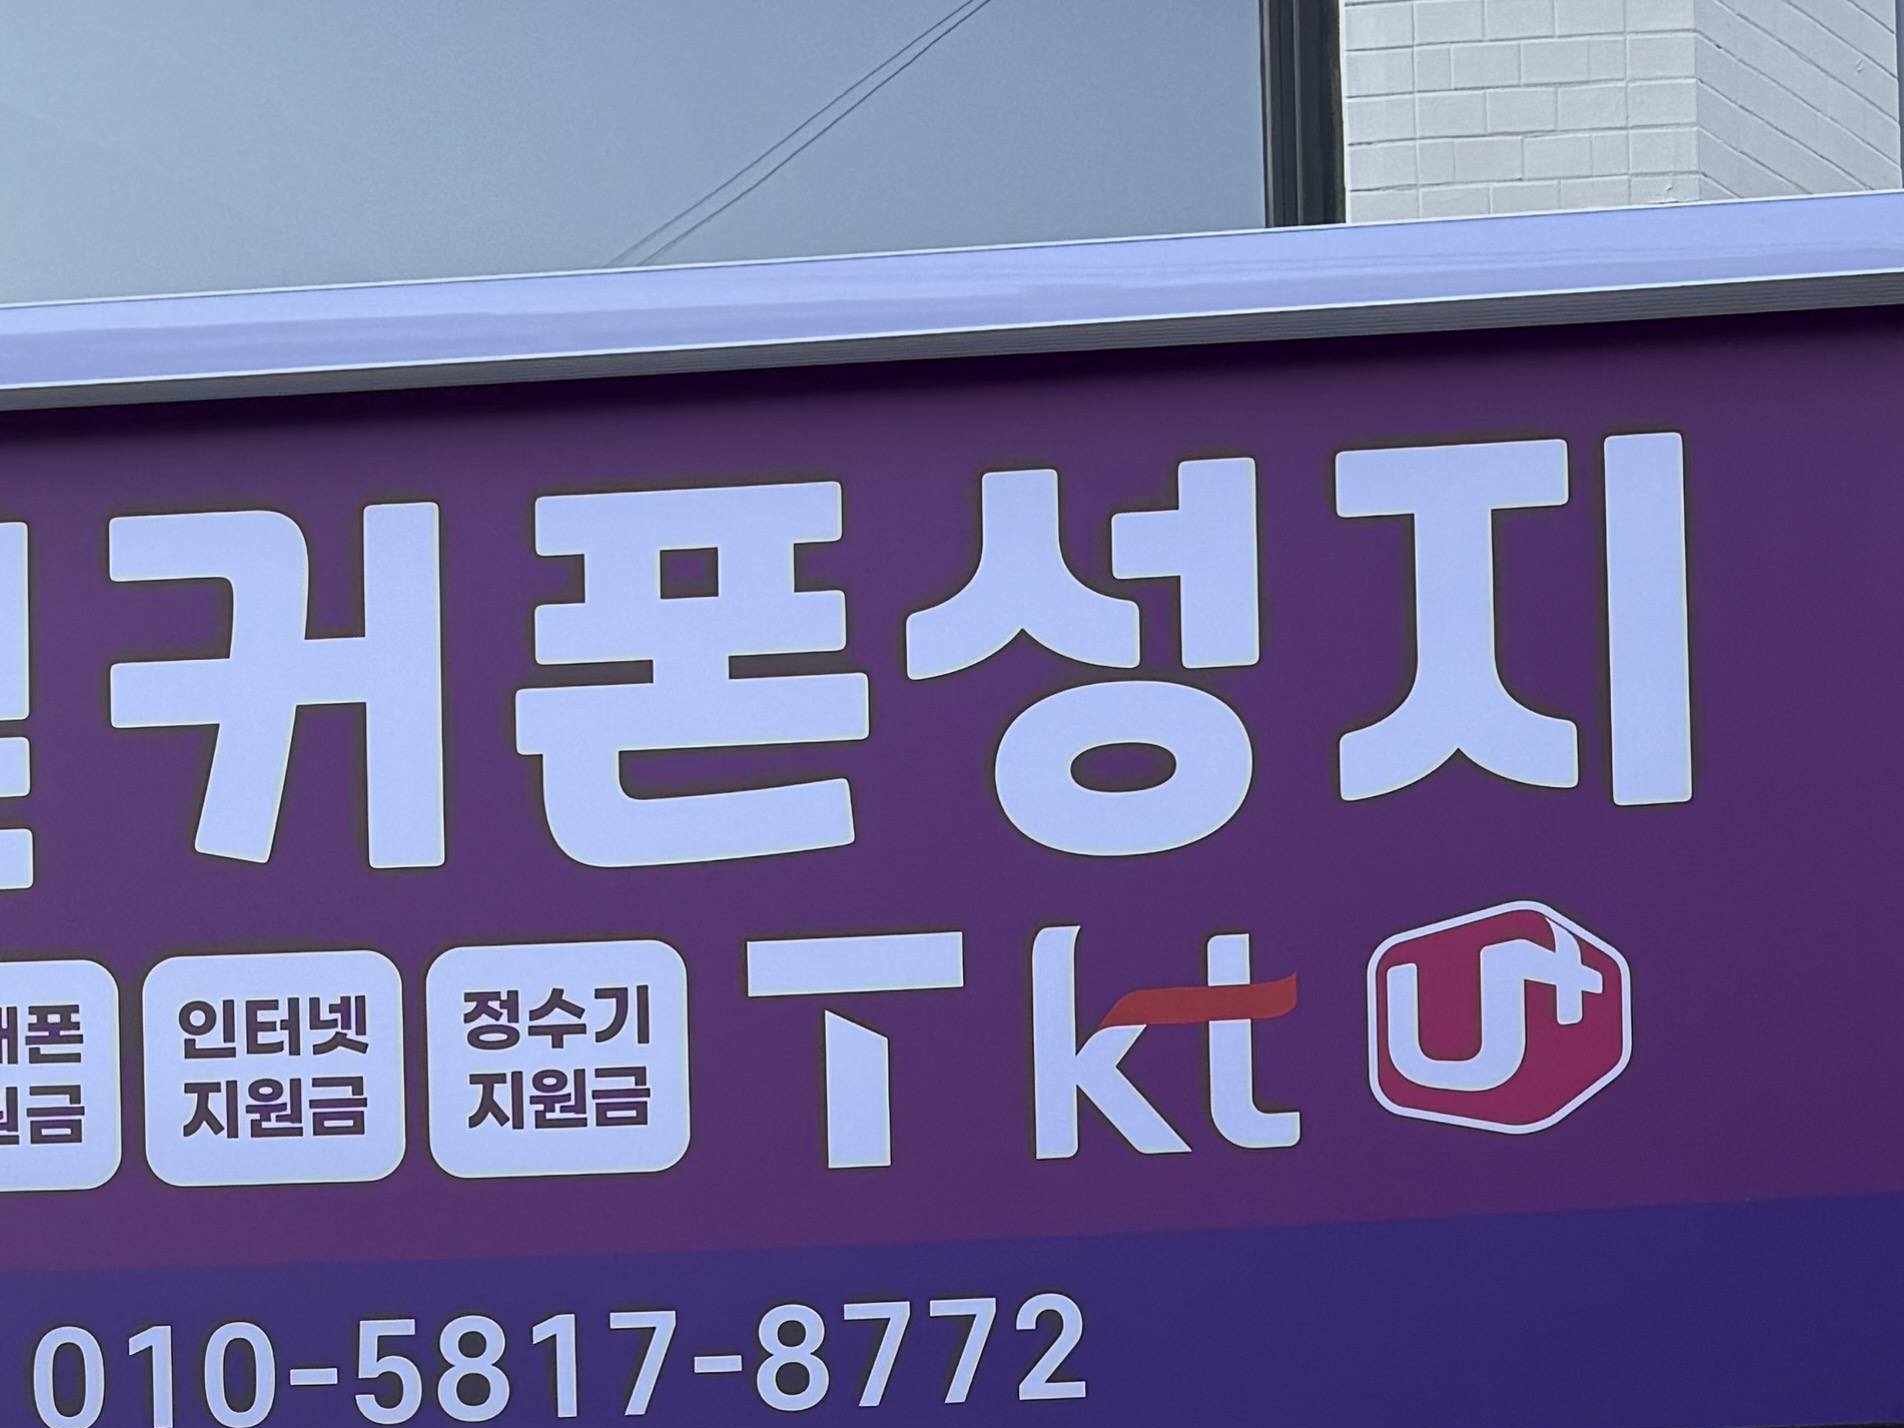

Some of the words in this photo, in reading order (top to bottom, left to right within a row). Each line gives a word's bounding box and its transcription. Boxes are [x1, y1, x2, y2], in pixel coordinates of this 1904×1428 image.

[177, 995, 369, 1060] 인터넷
[462, 984, 651, 1051] 정수기
[1032, 925, 1301, 1160] kt
[182, 1076, 368, 1139] 지원금
[467, 1066, 651, 1130] 지원금
